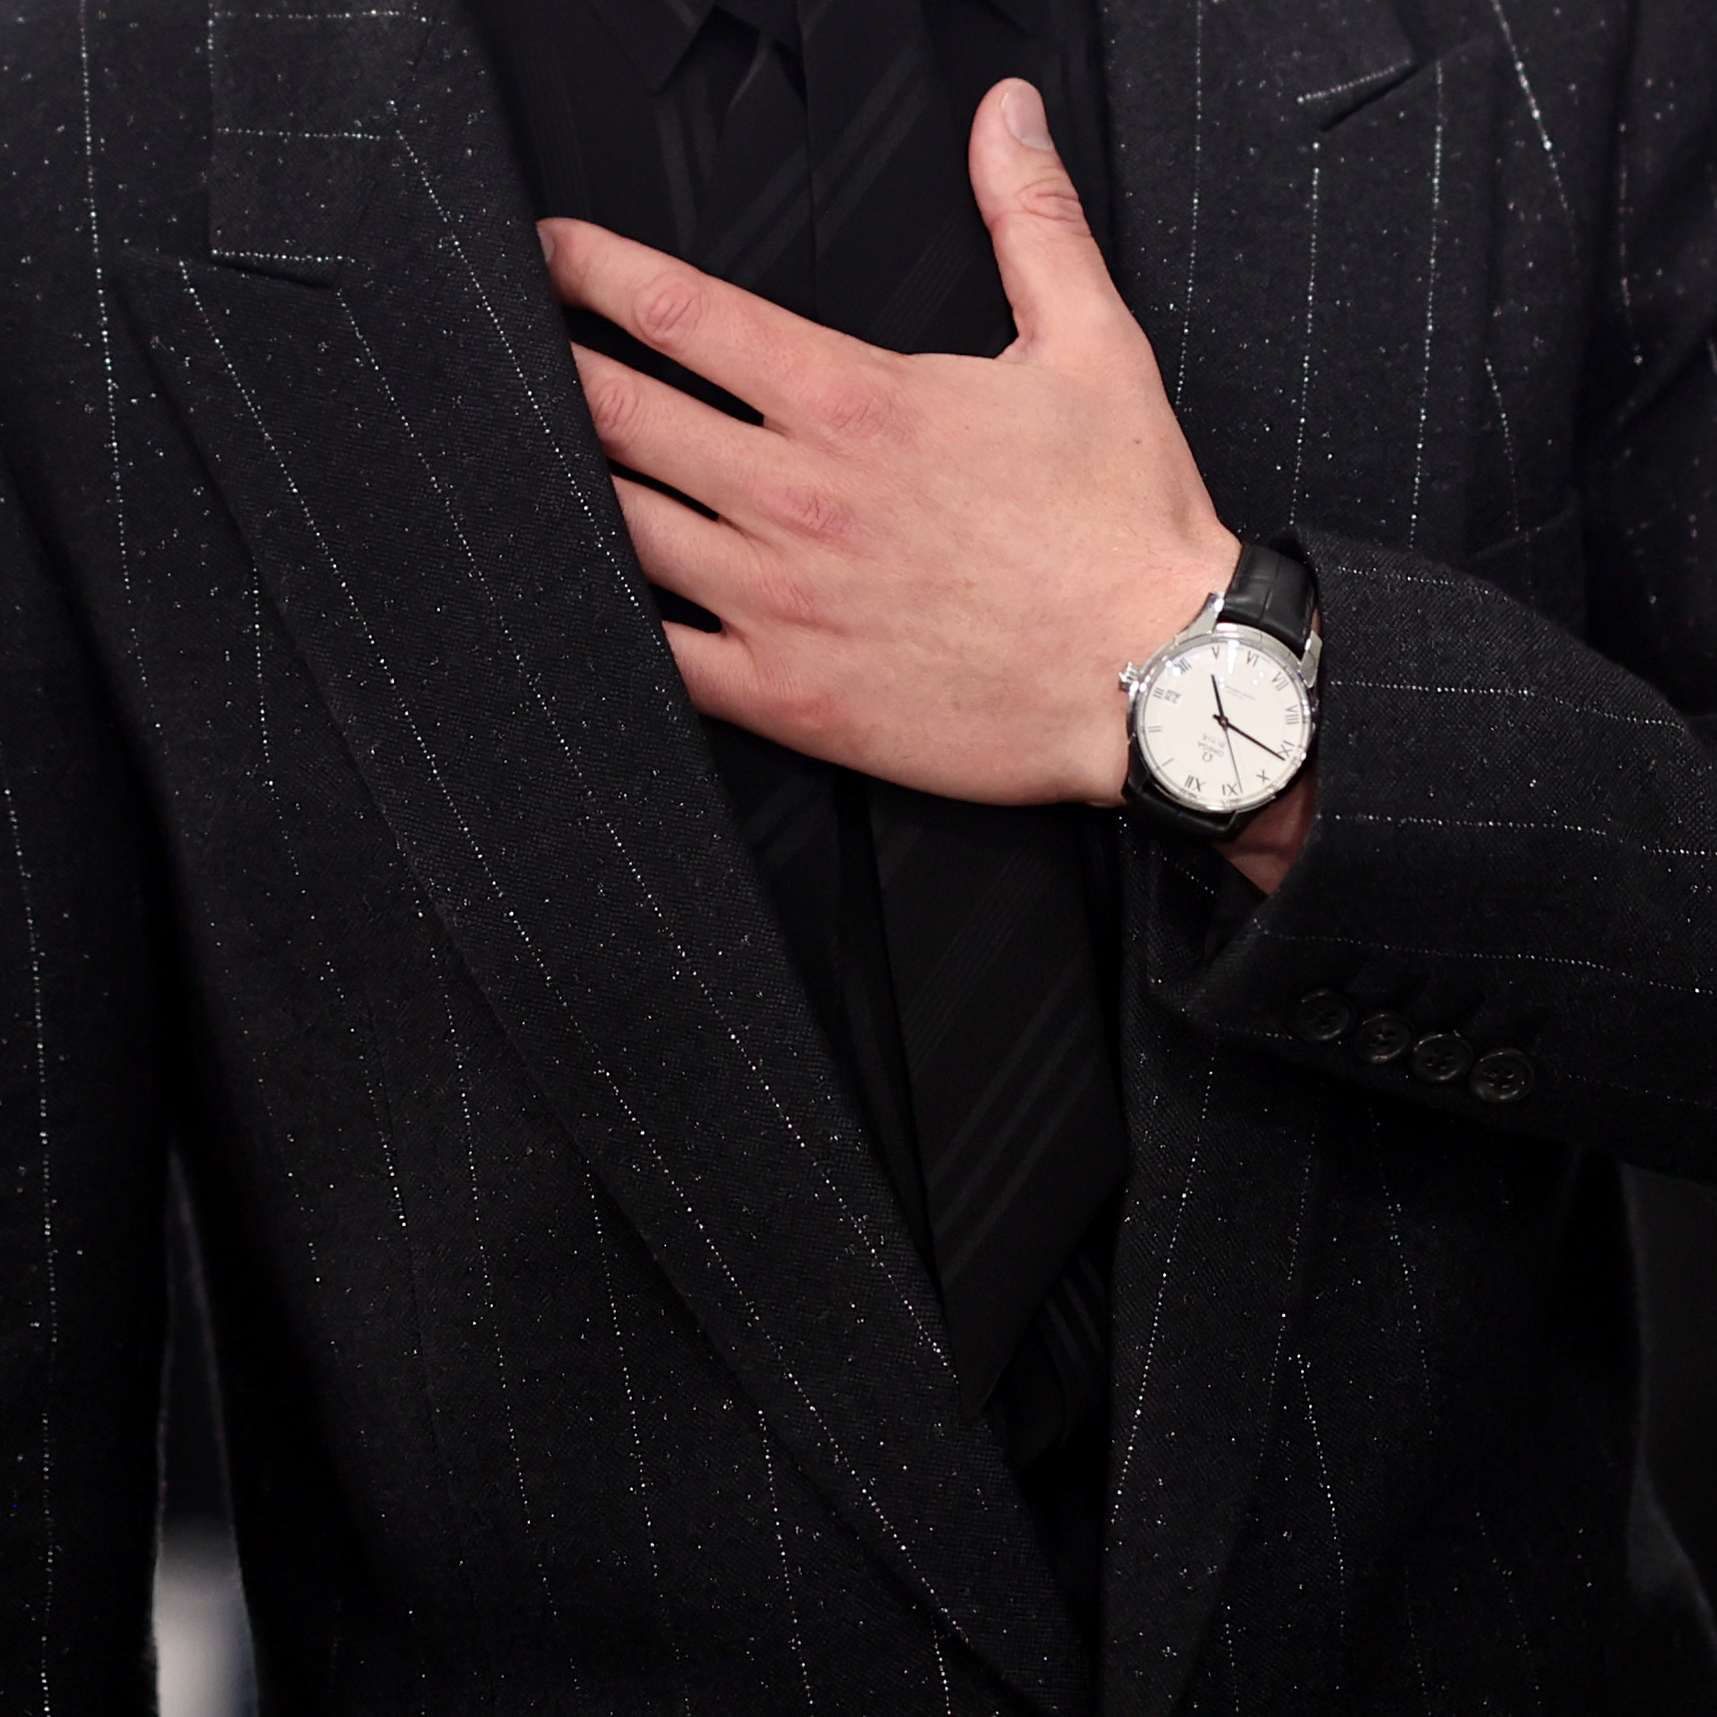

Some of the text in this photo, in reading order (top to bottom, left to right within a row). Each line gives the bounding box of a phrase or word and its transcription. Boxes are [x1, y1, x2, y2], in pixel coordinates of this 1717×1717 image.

[1211, 646, 1220, 659] V
[1247, 650, 1260, 667] VI
[1271, 671, 1289, 691] VII
[1285, 704, 1299, 725] VIII
[1278, 740, 1295, 758] IX
[1184, 774, 1206, 793] XII
[1256, 769, 1270, 784] X
[1222, 783, 1238, 796] XI
